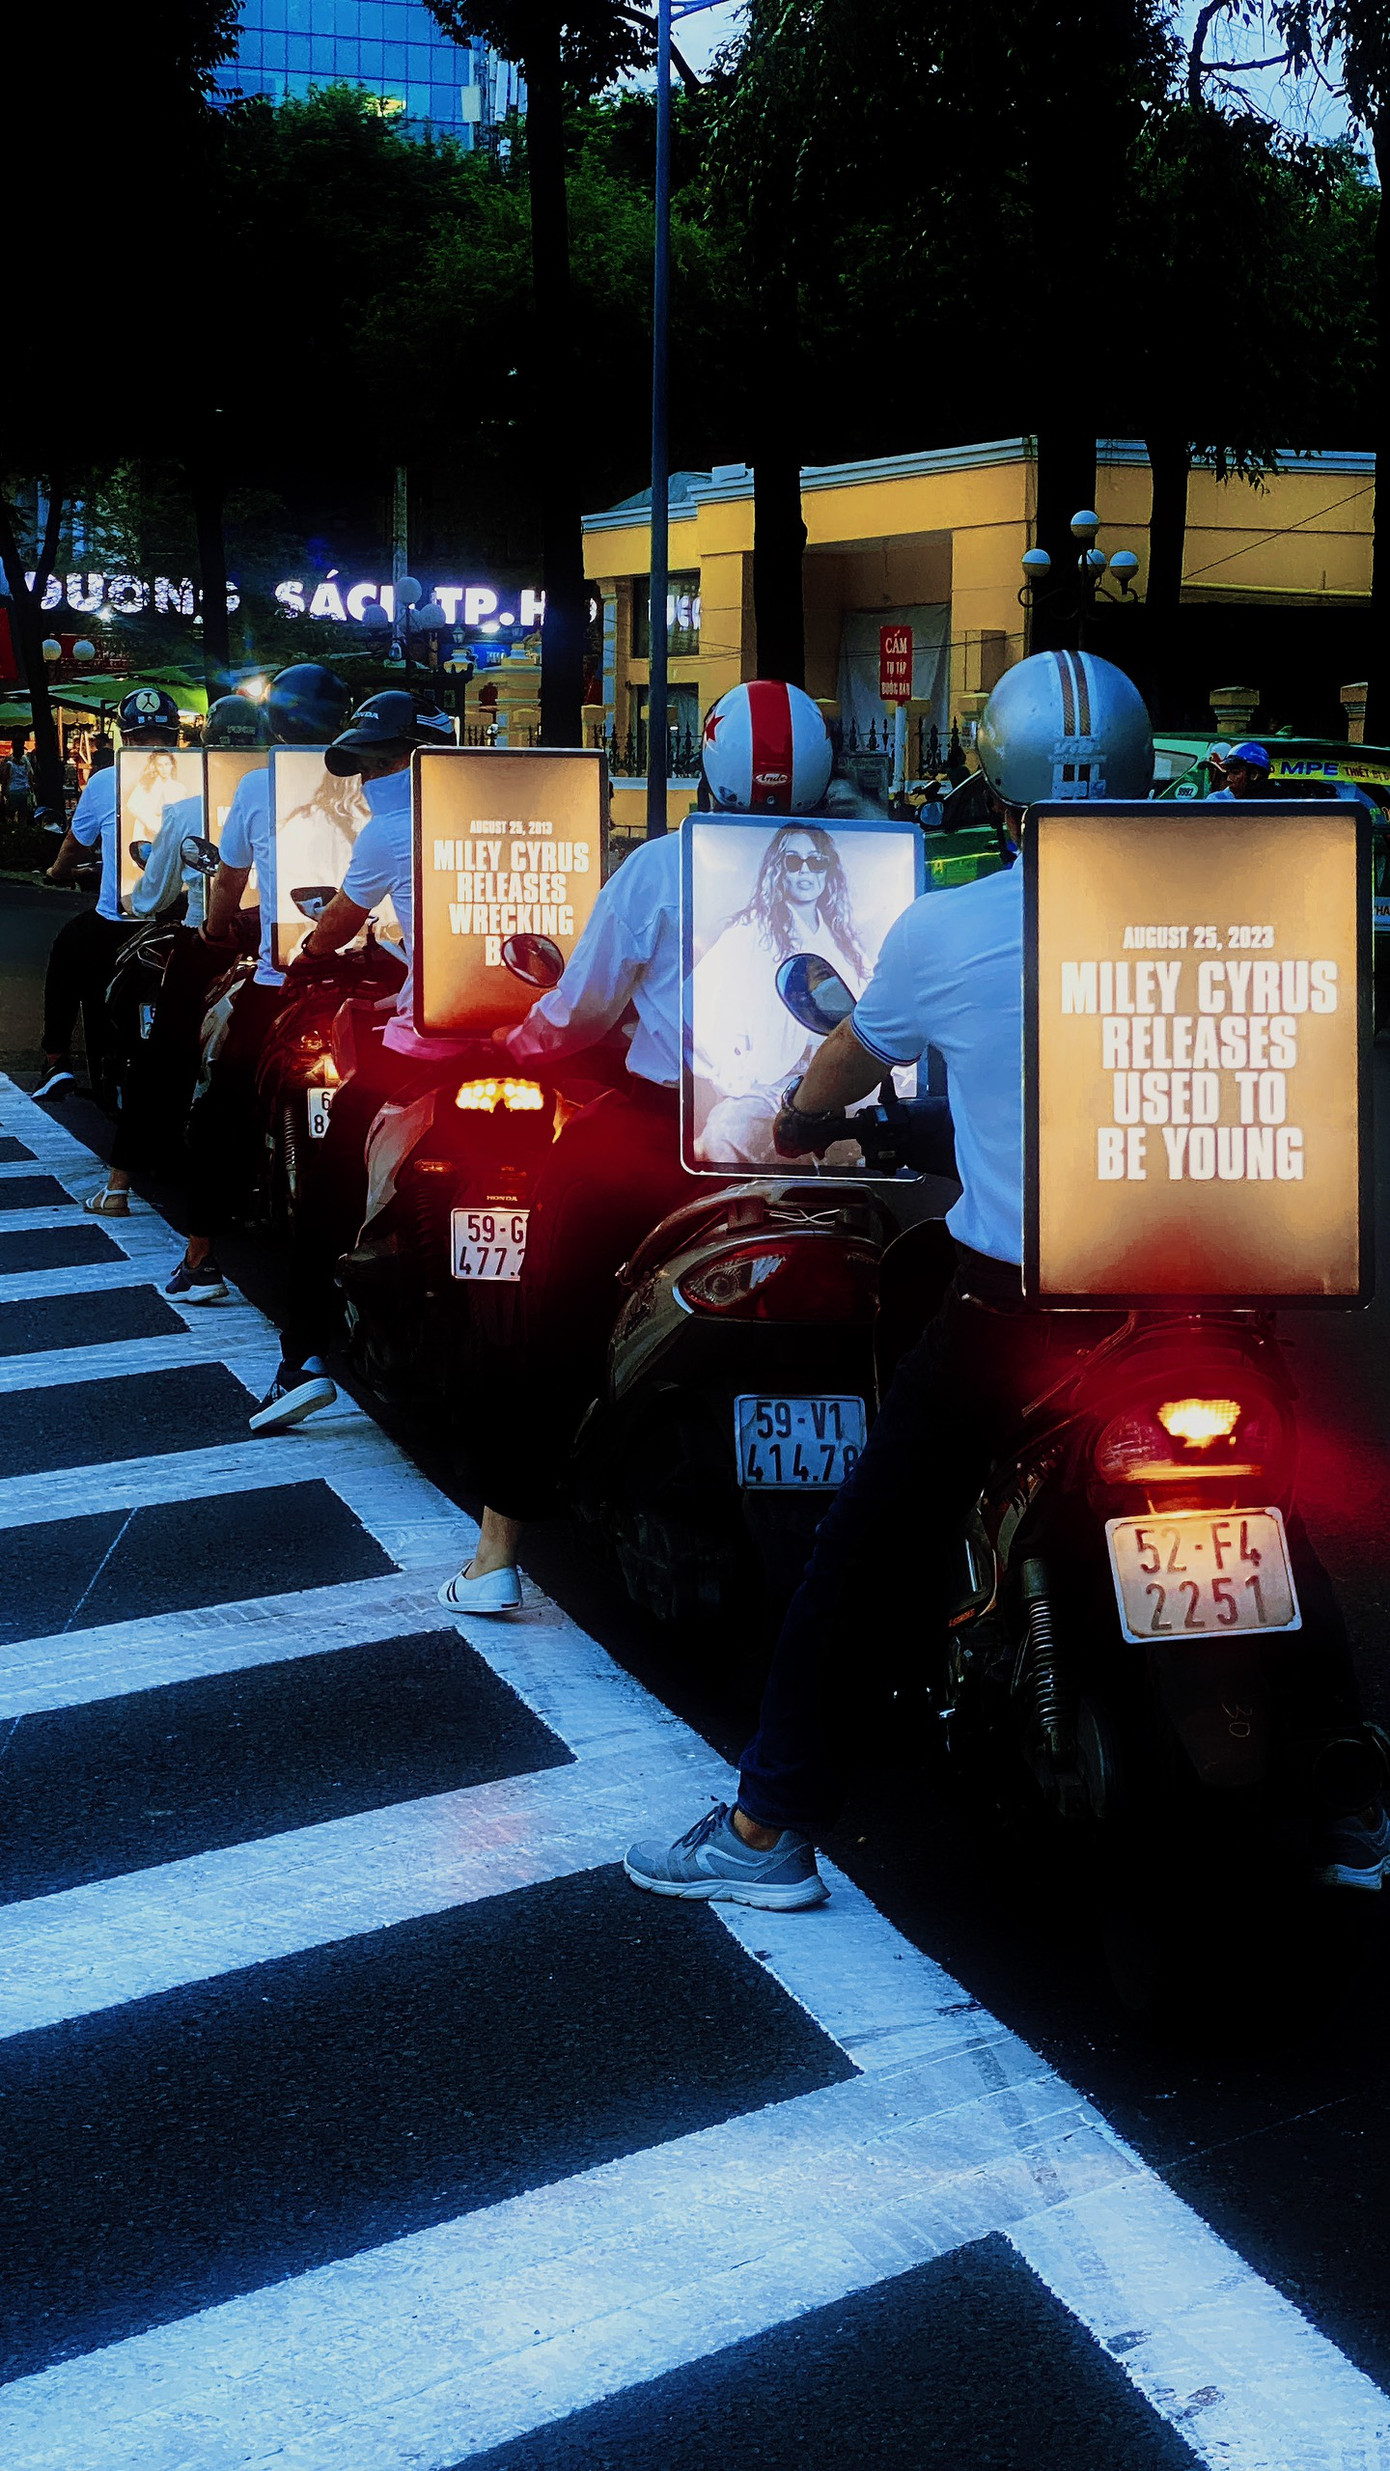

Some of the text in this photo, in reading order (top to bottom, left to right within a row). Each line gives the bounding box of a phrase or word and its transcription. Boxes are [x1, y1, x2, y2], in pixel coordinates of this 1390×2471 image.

[1280, 761, 1339, 777] MPE
[470, 820, 553, 836] AUGUST 25, 2013
[433, 839, 590, 873] MILEY CYRUS
[457, 871, 567, 904] RELEASES
[448, 903, 574, 936] WRECKING
[1122, 926, 1275, 951] AUGUST 25, 2023
[1061, 960, 1338, 1014] MILEY CYRUS
[1102, 1016, 1298, 1070] RELEASES
[1113, 1071, 1287, 1125] USED TO
[1097, 1127, 1305, 1180] BE YOUNG
[756, 1402, 843, 1441] 59-V1
[1134, 1520, 1262, 1575] 52-F4
[1145, 1575, 1267, 1630] 2251
